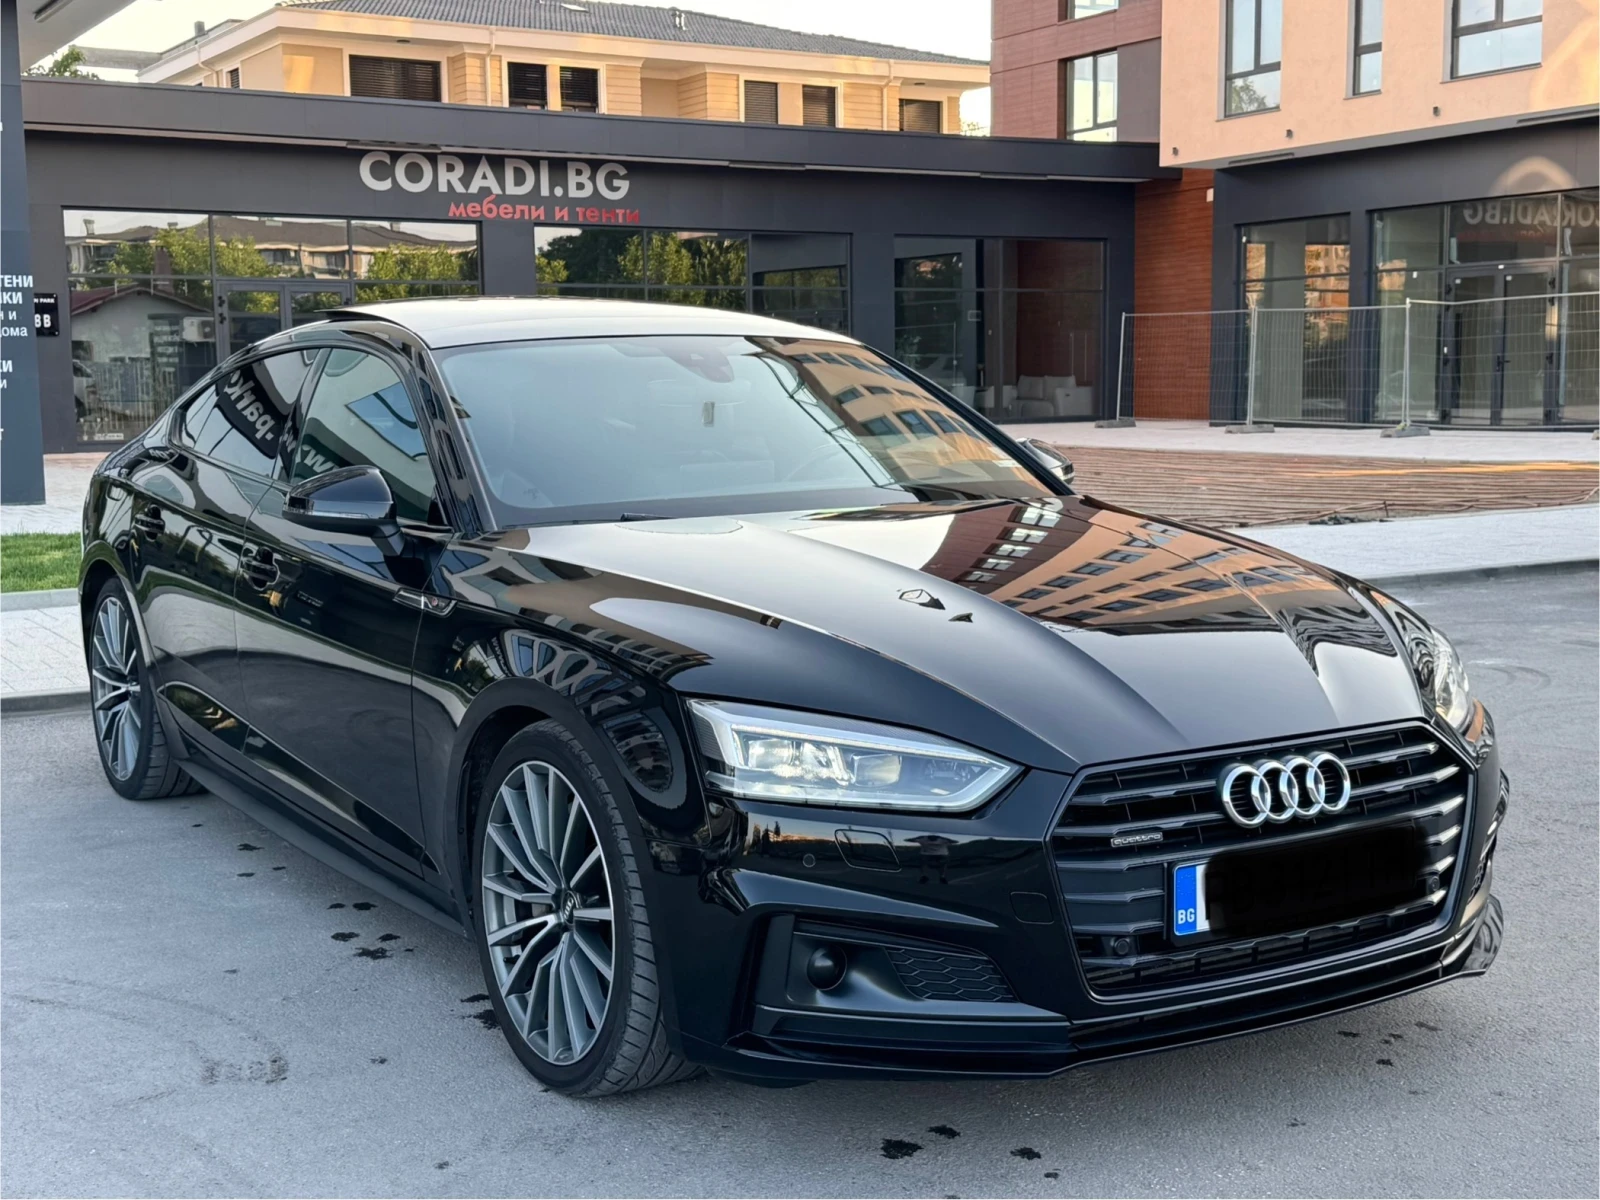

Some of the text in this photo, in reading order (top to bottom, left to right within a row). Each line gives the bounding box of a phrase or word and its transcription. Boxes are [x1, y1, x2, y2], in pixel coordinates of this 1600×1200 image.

[359, 151, 630, 200] CORADI.BG
[449, 195, 640, 223] мебели и тенти
[0, 291, 23, 304] КИ
[0, 326, 28, 338] ома
[1113, 834, 1162, 847] quattro
[1177, 908, 1195, 924] BG
